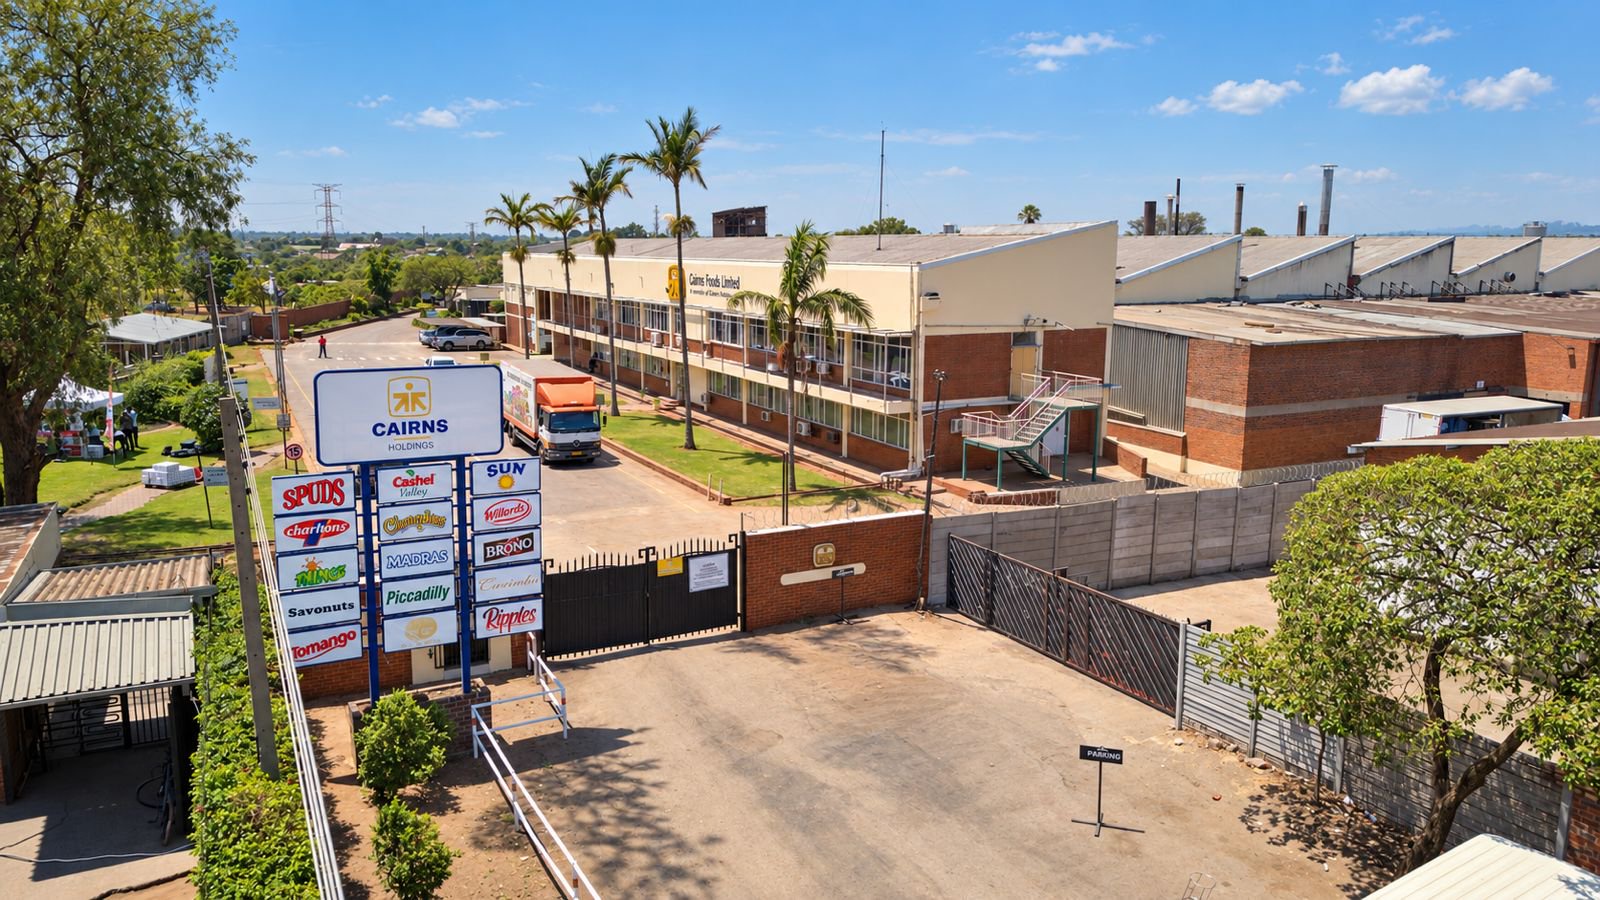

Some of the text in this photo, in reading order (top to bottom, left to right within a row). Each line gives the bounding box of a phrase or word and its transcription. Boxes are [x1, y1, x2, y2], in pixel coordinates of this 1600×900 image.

[705, 274, 720, 288] Foods
[372, 419, 448, 437] CAIRNS
[288, 447, 300, 457] 15
[388, 442, 434, 451] HOLDINGS
[486, 462, 526, 478] SUN
[392, 473, 435, 488] Cashel
[282, 477, 345, 511] SPUDS
[399, 487, 428, 498] Valley
[486, 537, 532, 559] BRONO
[386, 549, 449, 569] MADRAS
[386, 585, 450, 605] Piccadilly
[288, 602, 355, 618] Savonuts
[482, 605, 537, 634] Ripples
[291, 630, 357, 659] Tomango
